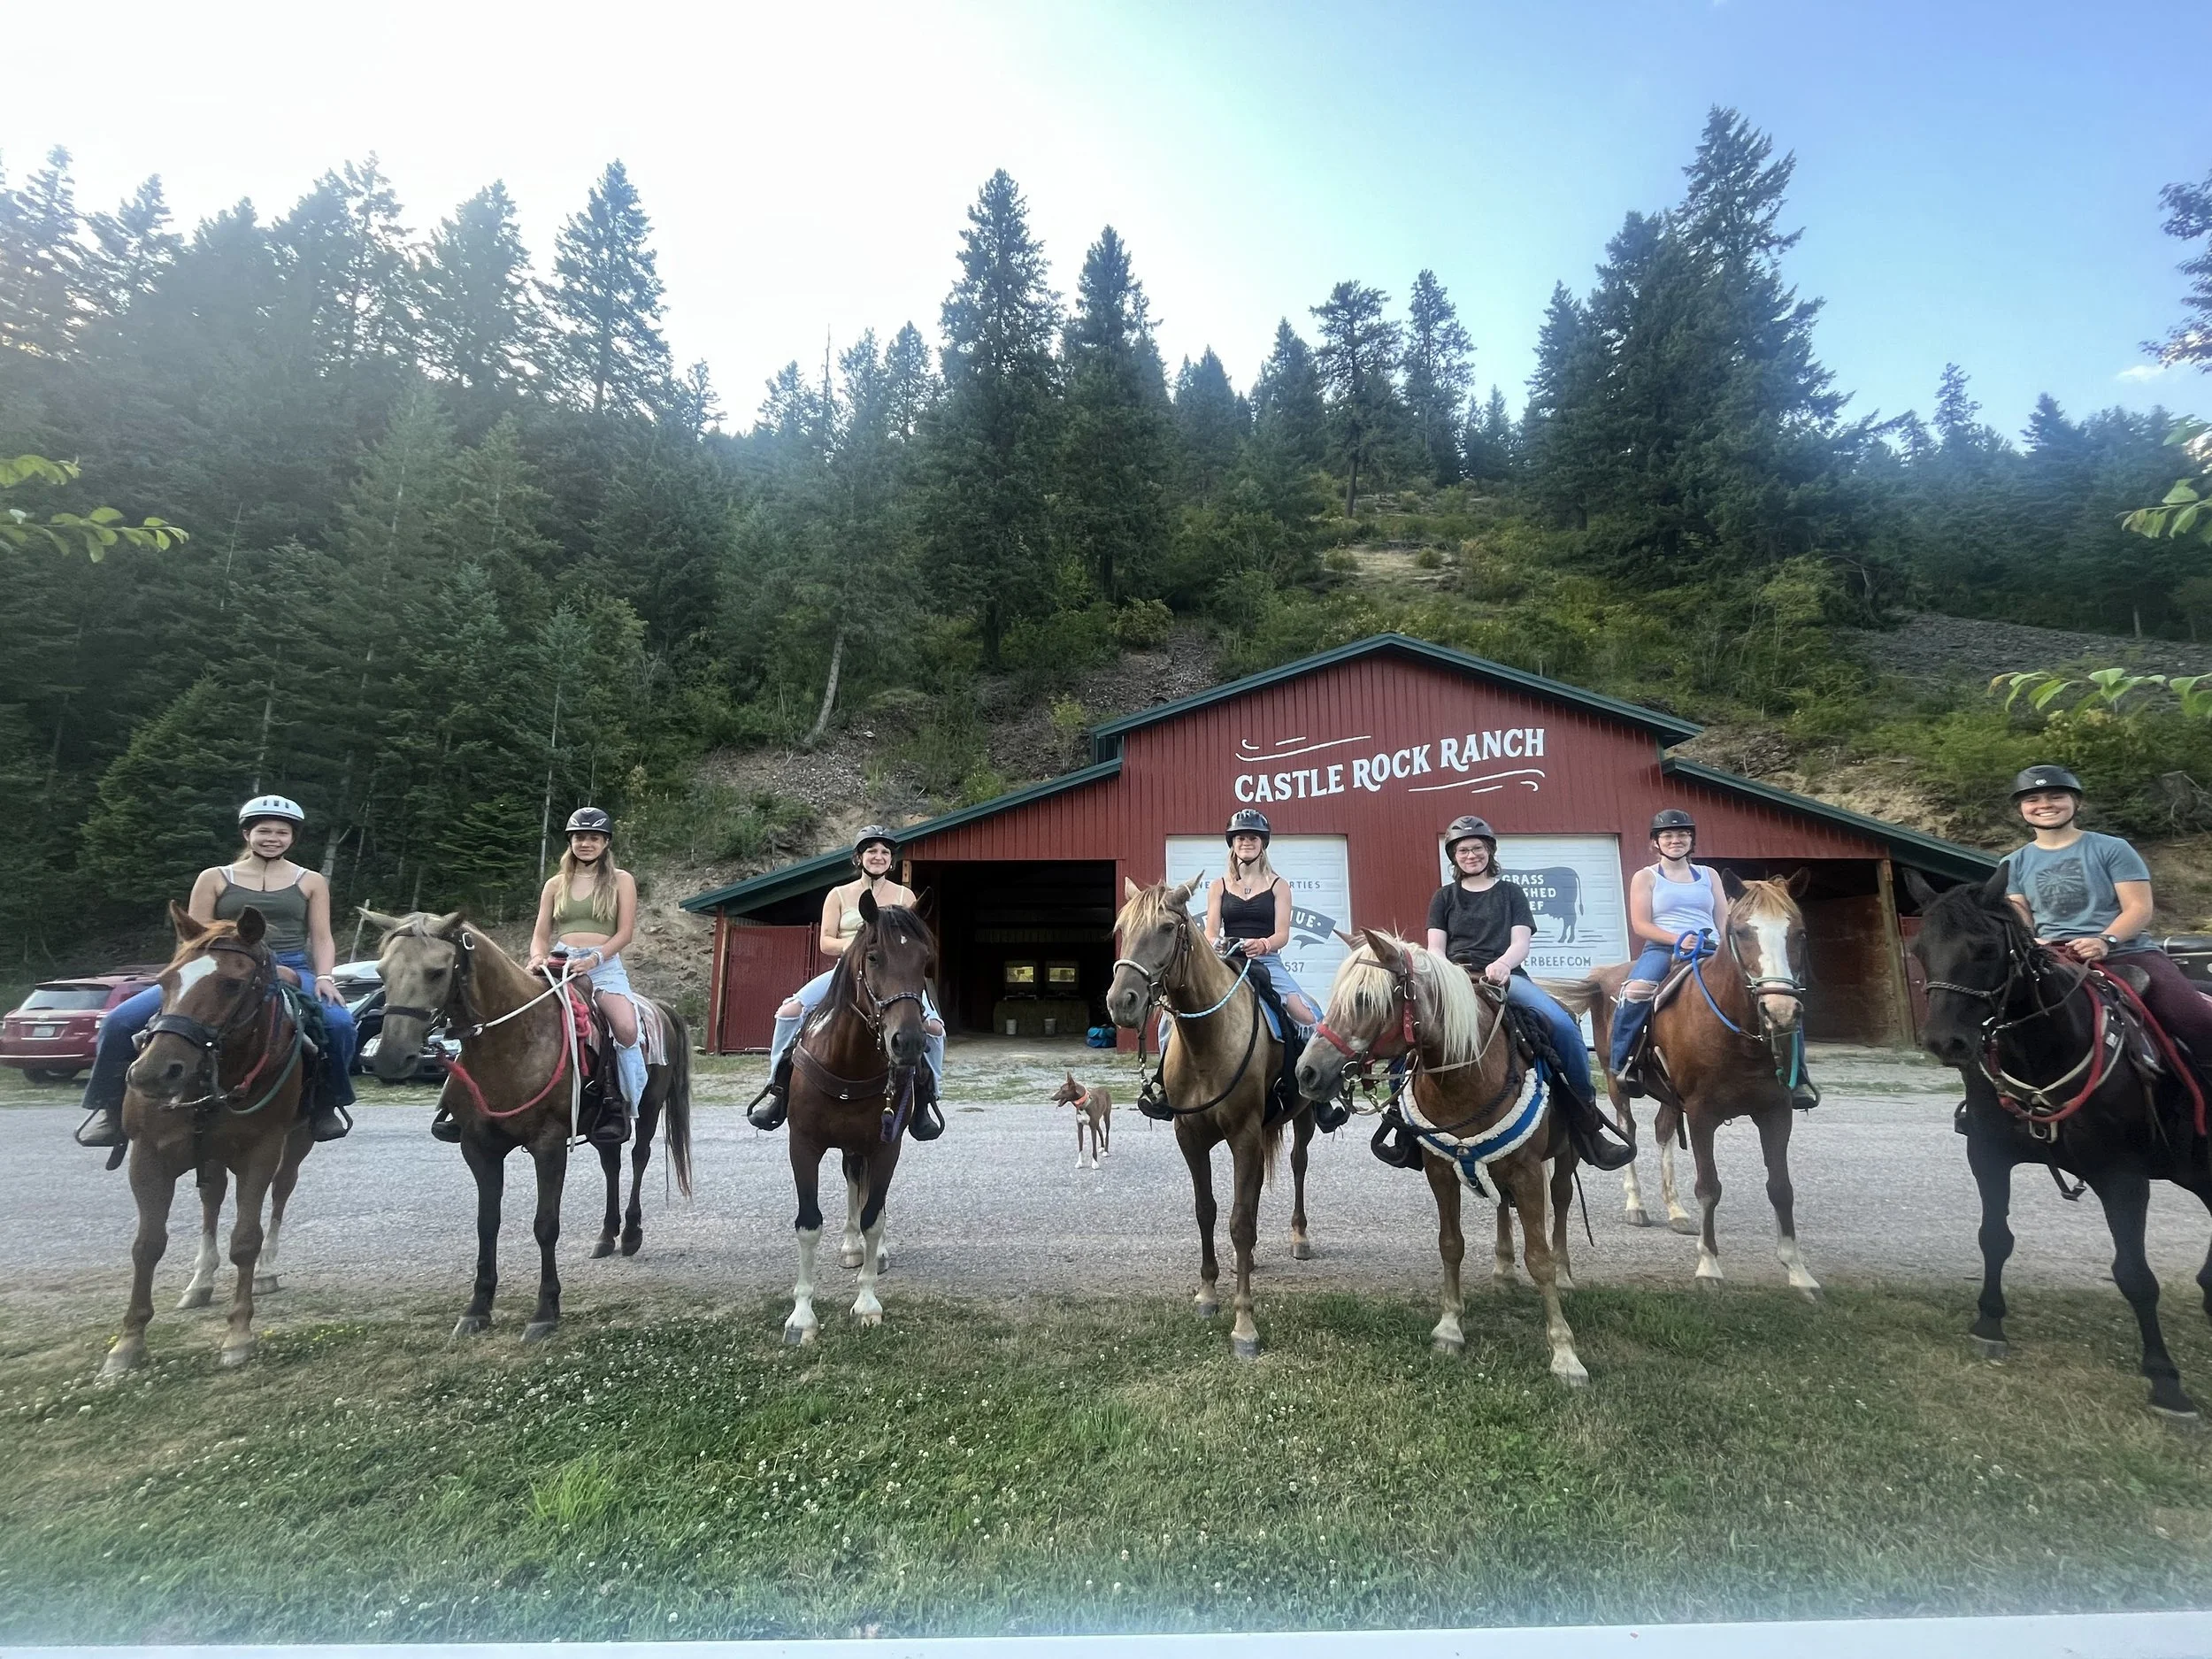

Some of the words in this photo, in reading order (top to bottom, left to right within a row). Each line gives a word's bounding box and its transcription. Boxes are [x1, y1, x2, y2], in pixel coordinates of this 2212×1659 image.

[1234, 765, 1345, 803] CASTLE
[1352, 743, 1432, 792] ROCK
[1440, 728, 1545, 772] RANCH
[1289, 880, 1321, 889] RTIES
[1502, 874, 1544, 885] GRASS
[1522, 887, 1556, 898] SHED
[1529, 901, 1544, 911] EF
[1285, 962, 1304, 972] 537
